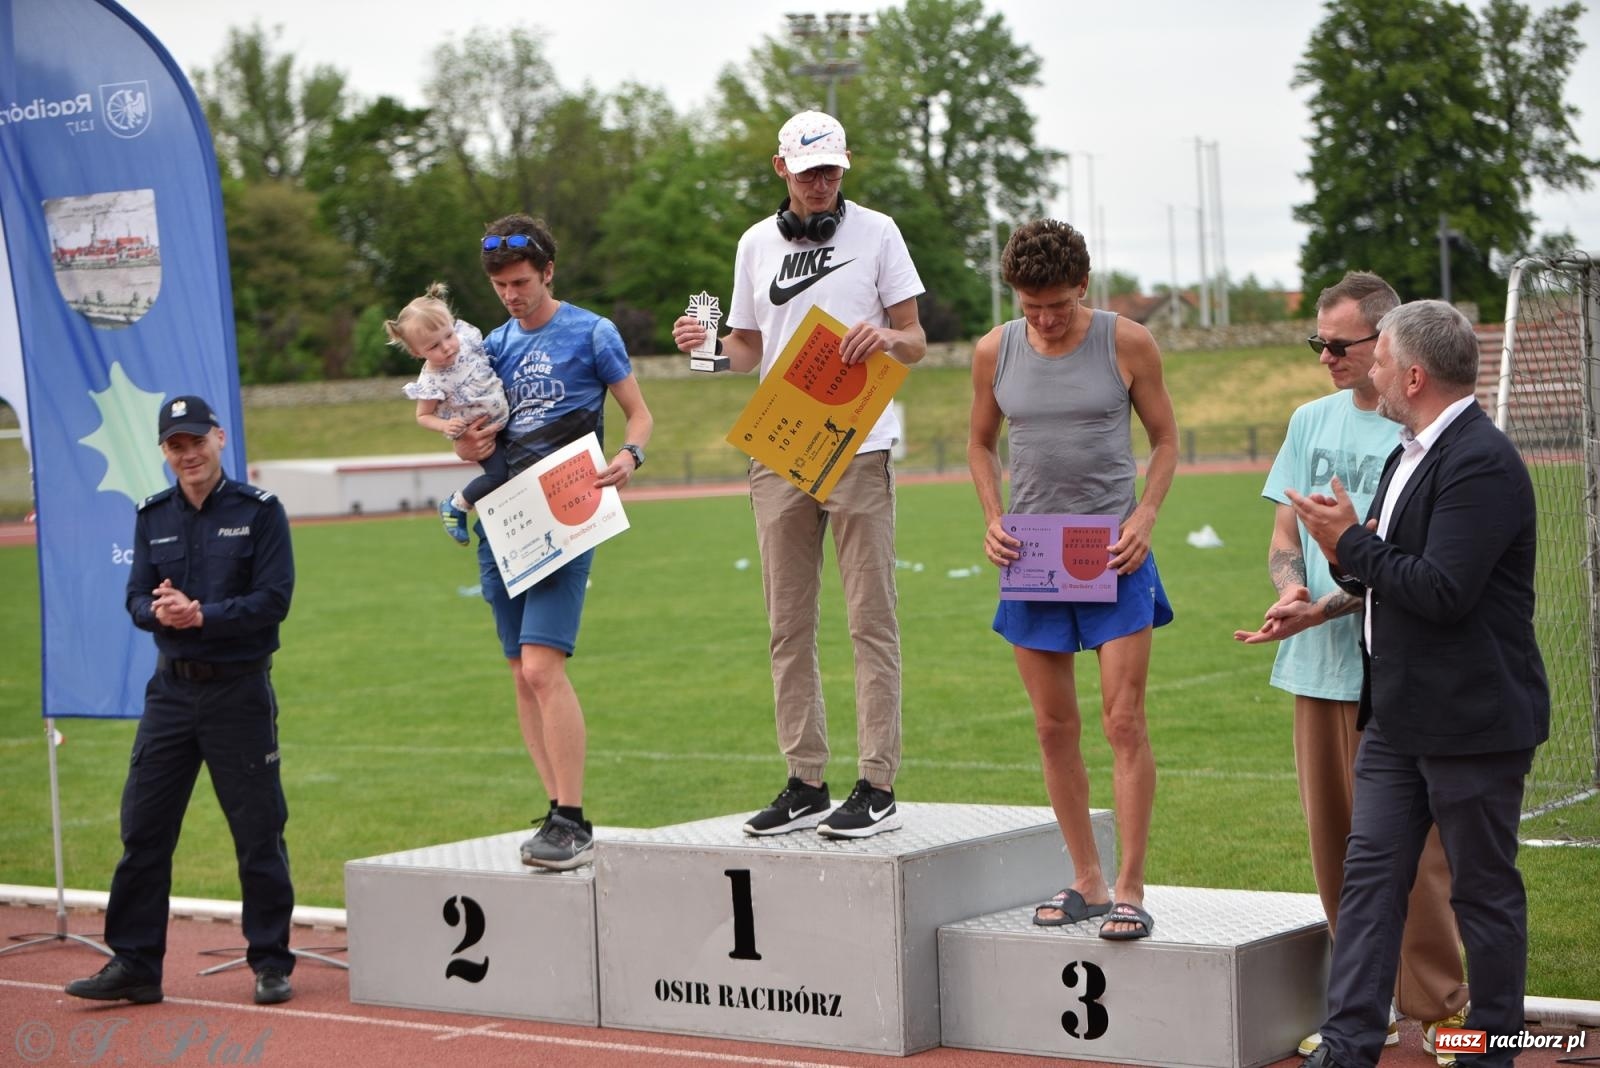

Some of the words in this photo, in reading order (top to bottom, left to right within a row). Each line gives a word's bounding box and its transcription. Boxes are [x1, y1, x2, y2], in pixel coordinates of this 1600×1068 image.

[779, 246, 835, 281] NIKE
[523, 364, 553, 375] HUGE
[506, 380, 565, 410] WORLD
[768, 417, 789, 443] Bieg
[779, 438, 791, 452] 10
[789, 419, 804, 436] km
[217, 525, 251, 537] POLICJA
[503, 510, 525, 527] Bieg
[723, 869, 763, 961] 1
[442, 894, 491, 984] 2
[654, 978, 711, 1006] OSIR
[718, 984, 843, 1018] RACIBÓRZ
[1061, 960, 1110, 1041] 3
